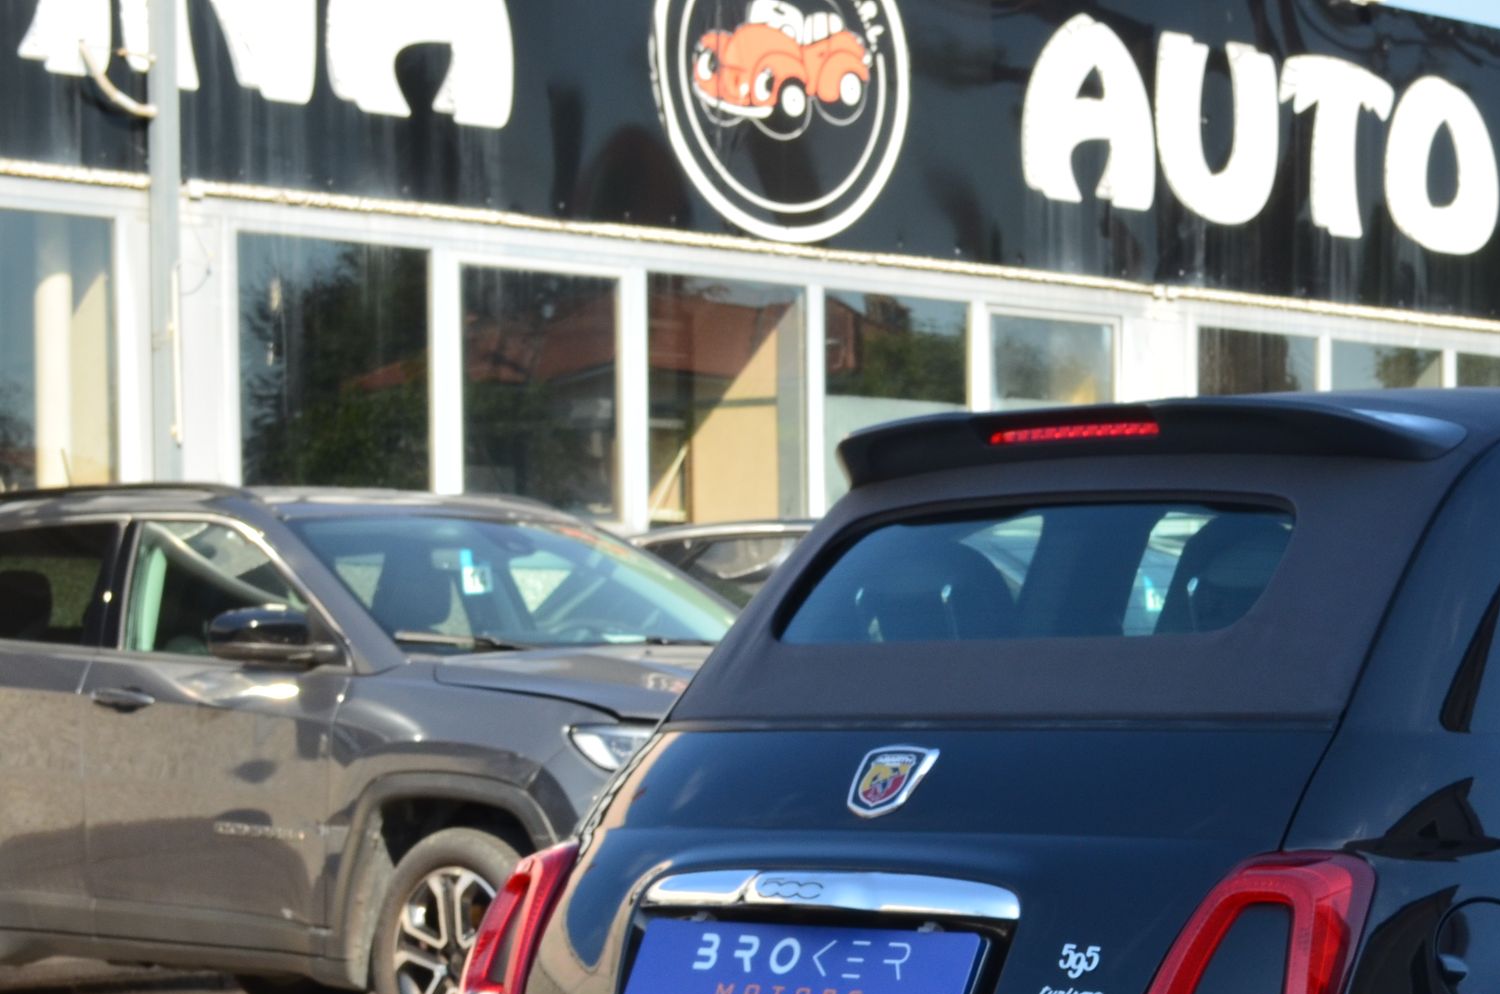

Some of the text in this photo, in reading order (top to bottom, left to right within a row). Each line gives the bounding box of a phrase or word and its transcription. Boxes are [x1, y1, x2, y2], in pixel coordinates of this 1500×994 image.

[1021, 13, 1500, 256] AUTO
[692, 932, 912, 981] BROKER
[1058, 943, 1102, 979] 595
